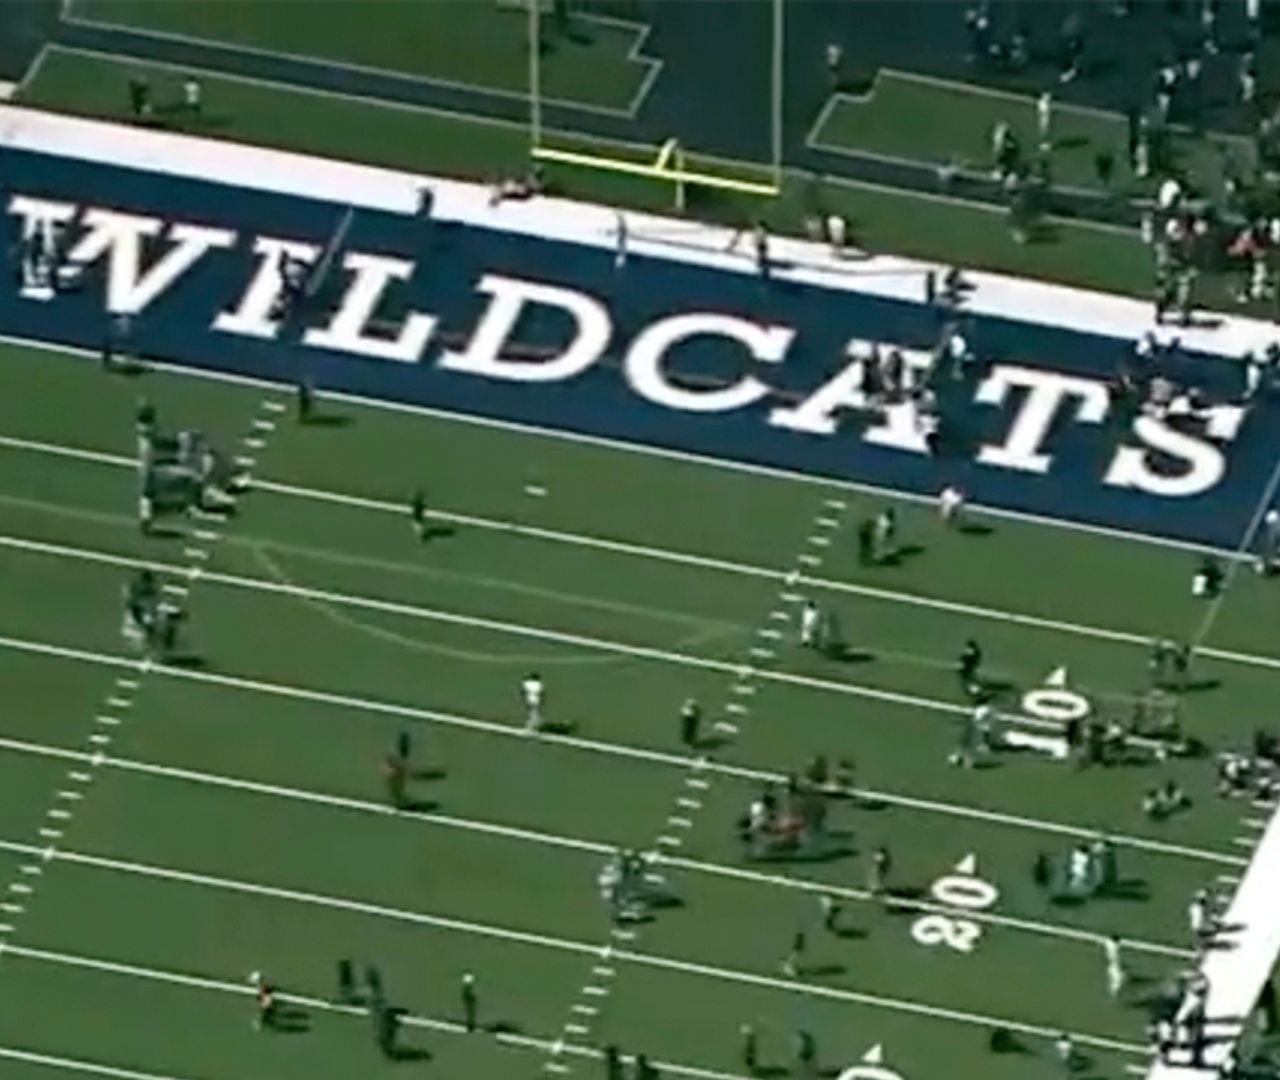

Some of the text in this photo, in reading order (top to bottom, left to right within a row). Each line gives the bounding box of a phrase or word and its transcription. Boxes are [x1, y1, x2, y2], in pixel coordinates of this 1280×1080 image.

[9, 198, 1246, 499] WILDCATS
[1005, 689, 1088, 759] 10
[911, 877, 998, 951] 20
